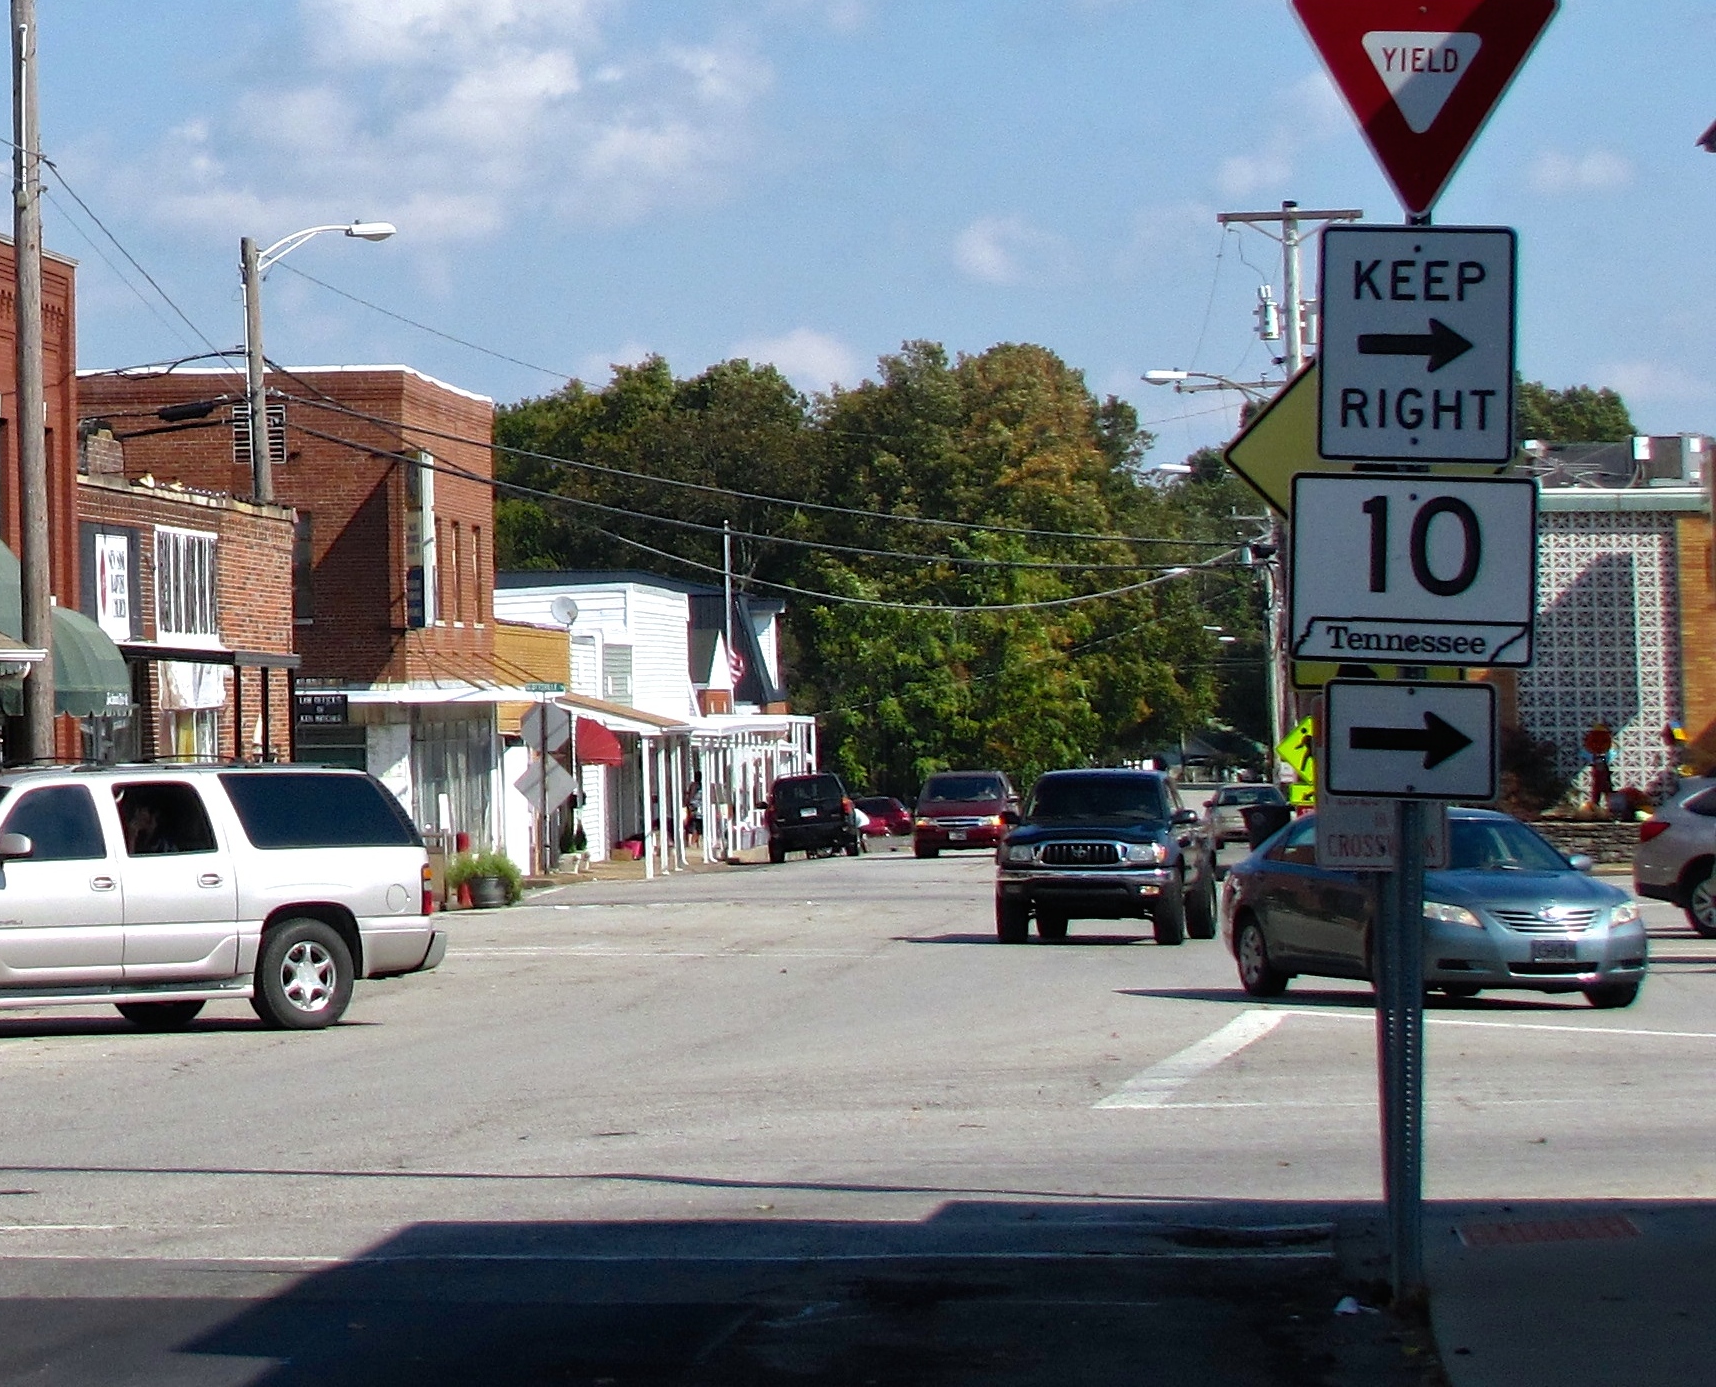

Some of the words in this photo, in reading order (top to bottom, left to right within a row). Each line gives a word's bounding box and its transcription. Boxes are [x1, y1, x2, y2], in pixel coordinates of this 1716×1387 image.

[1382, 47, 1458, 73] YIELD
[1354, 259, 1486, 301] KEEP
[1341, 387, 1496, 431] RIGHT
[1362, 495, 1482, 597] 10
[1326, 625, 1486, 655] Tennessee
[1327, 834, 1436, 857] CROSSK
